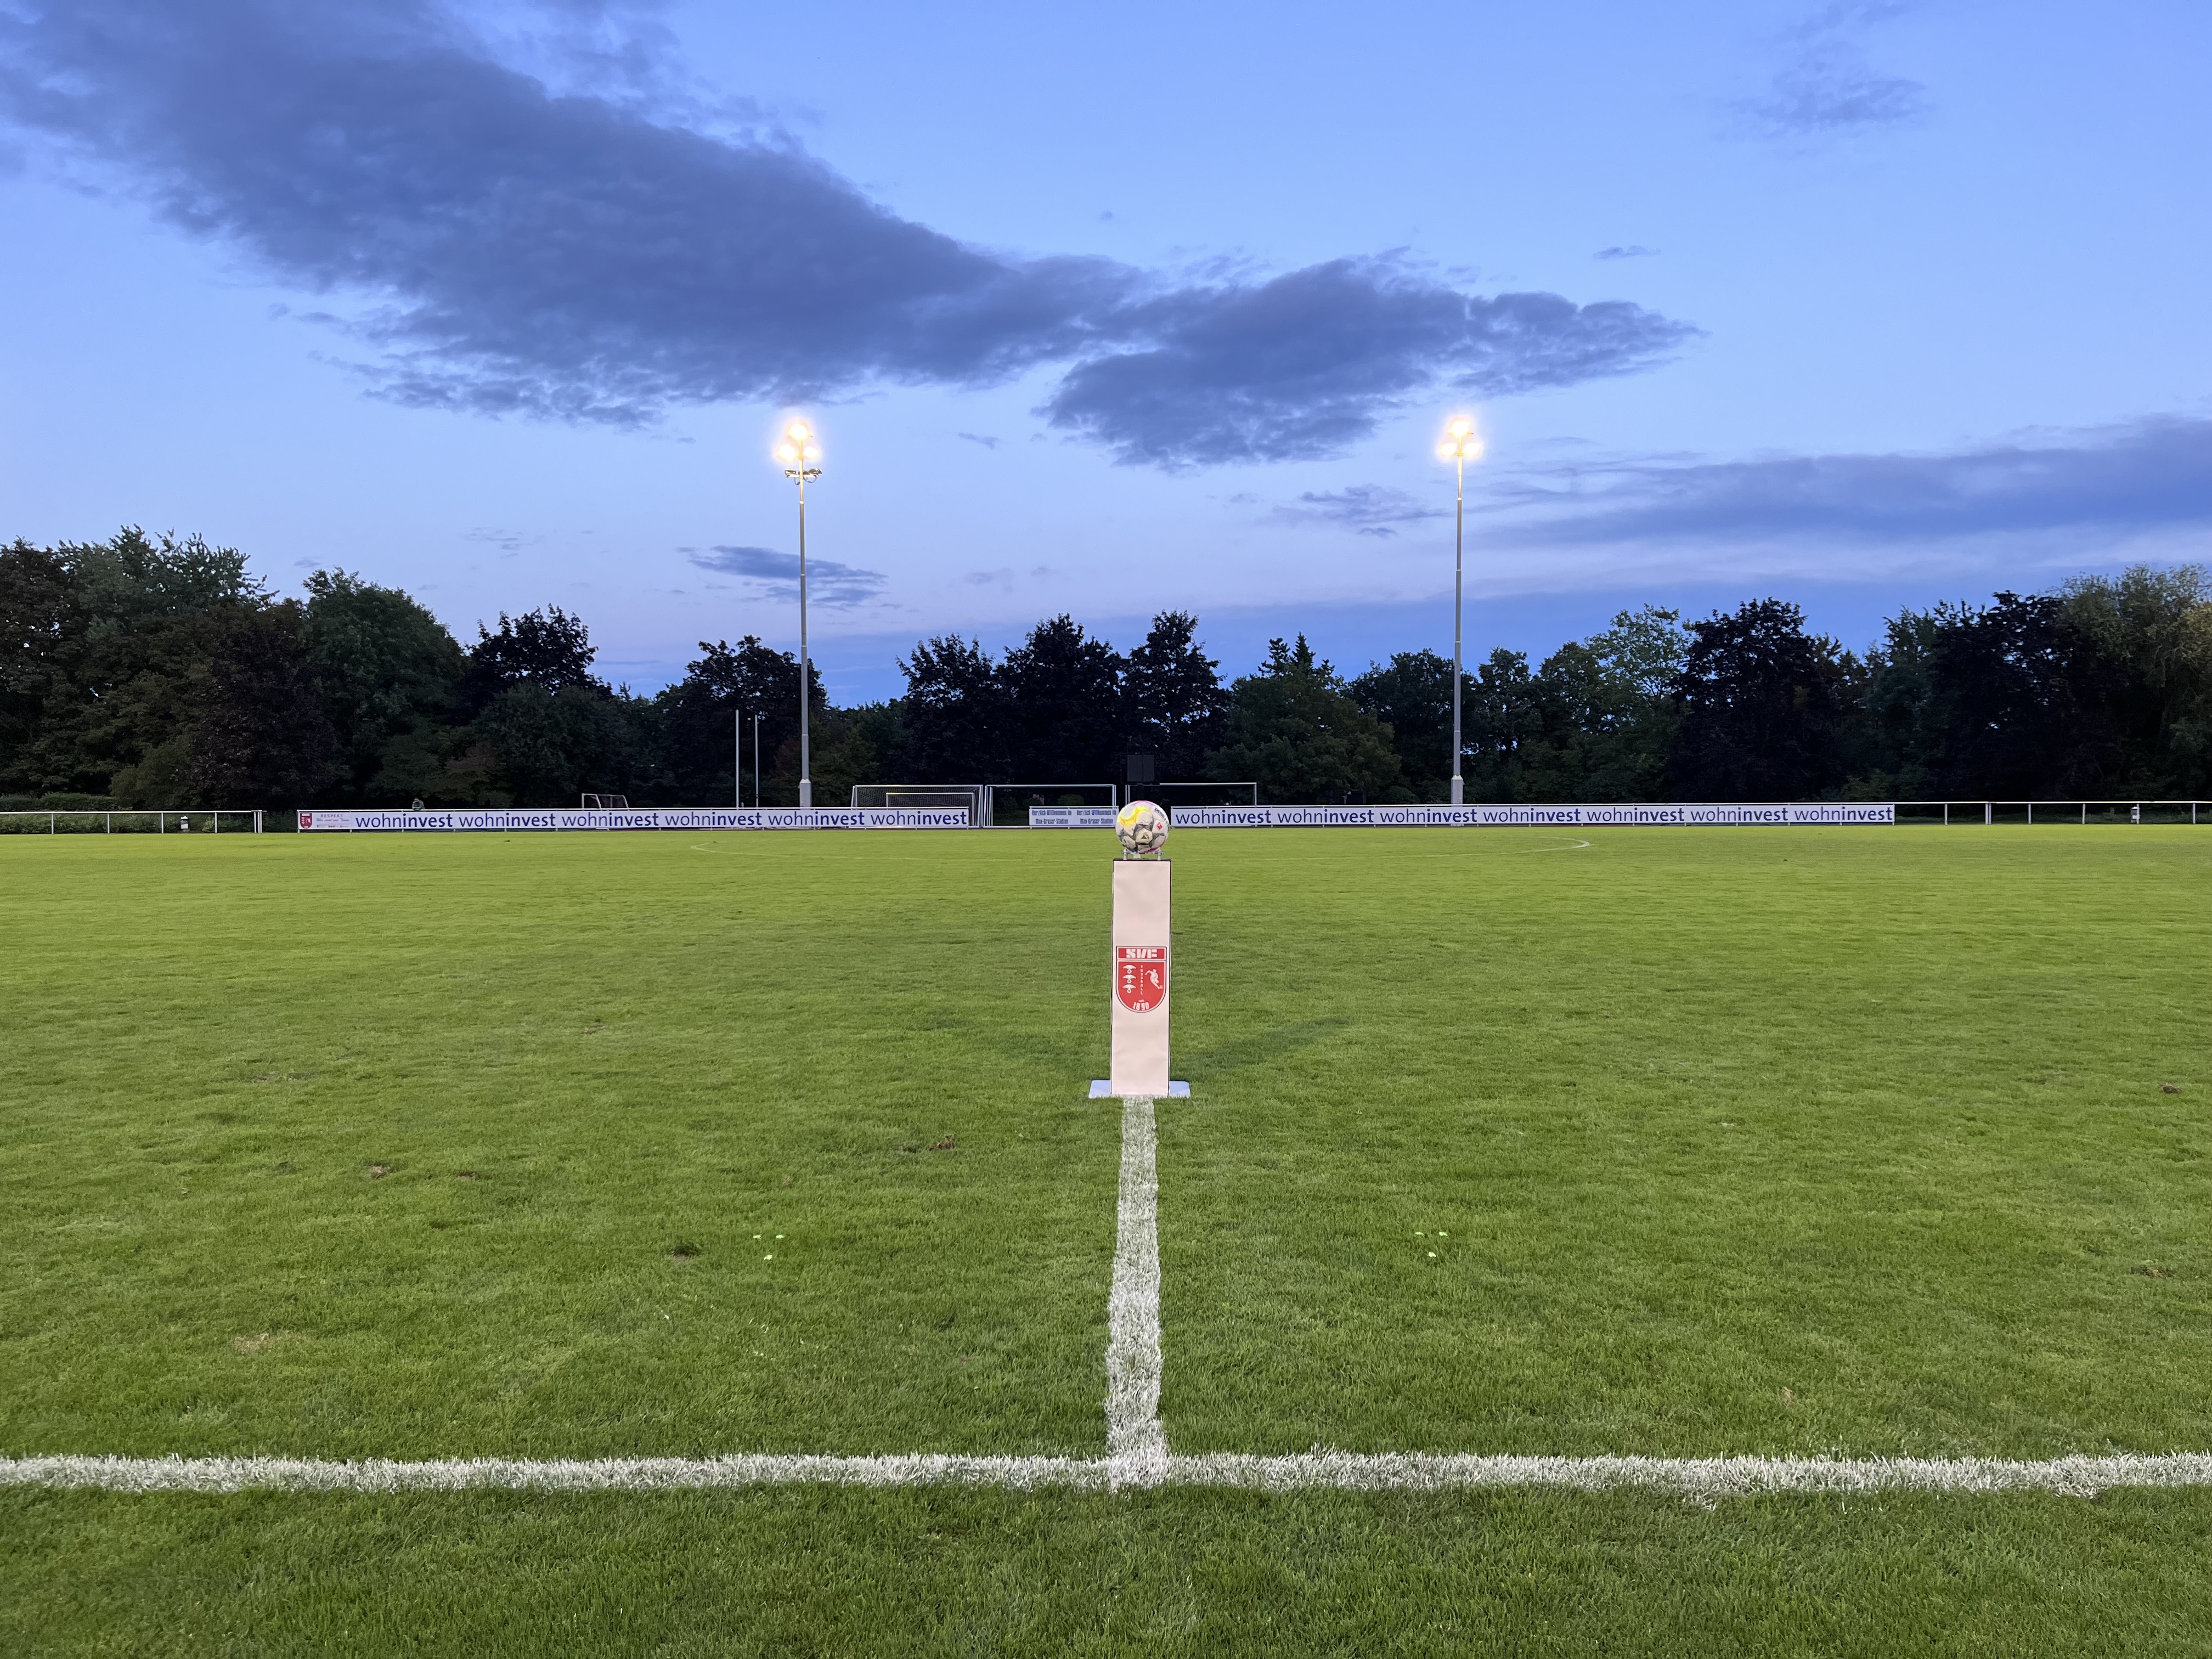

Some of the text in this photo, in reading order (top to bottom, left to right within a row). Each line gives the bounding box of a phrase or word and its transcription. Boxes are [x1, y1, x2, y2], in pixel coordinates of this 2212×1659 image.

[356, 811, 967, 827] wohninvest wohninvest wohninvest wohninvest wohninvest wohninvest
[1176, 810, 1271, 824] wohninvest
[1278, 809, 1374, 823] wohninvest
[1380, 809, 1477, 823] wohninvest
[1483, 808, 1581, 822] wohninvest
[1587, 808, 1684, 822] wohninvest
[1691, 808, 1788, 821] wohninvest
[1795, 806, 1892, 821] wohninvest
[1132, 1001, 1150, 1011] 1890
